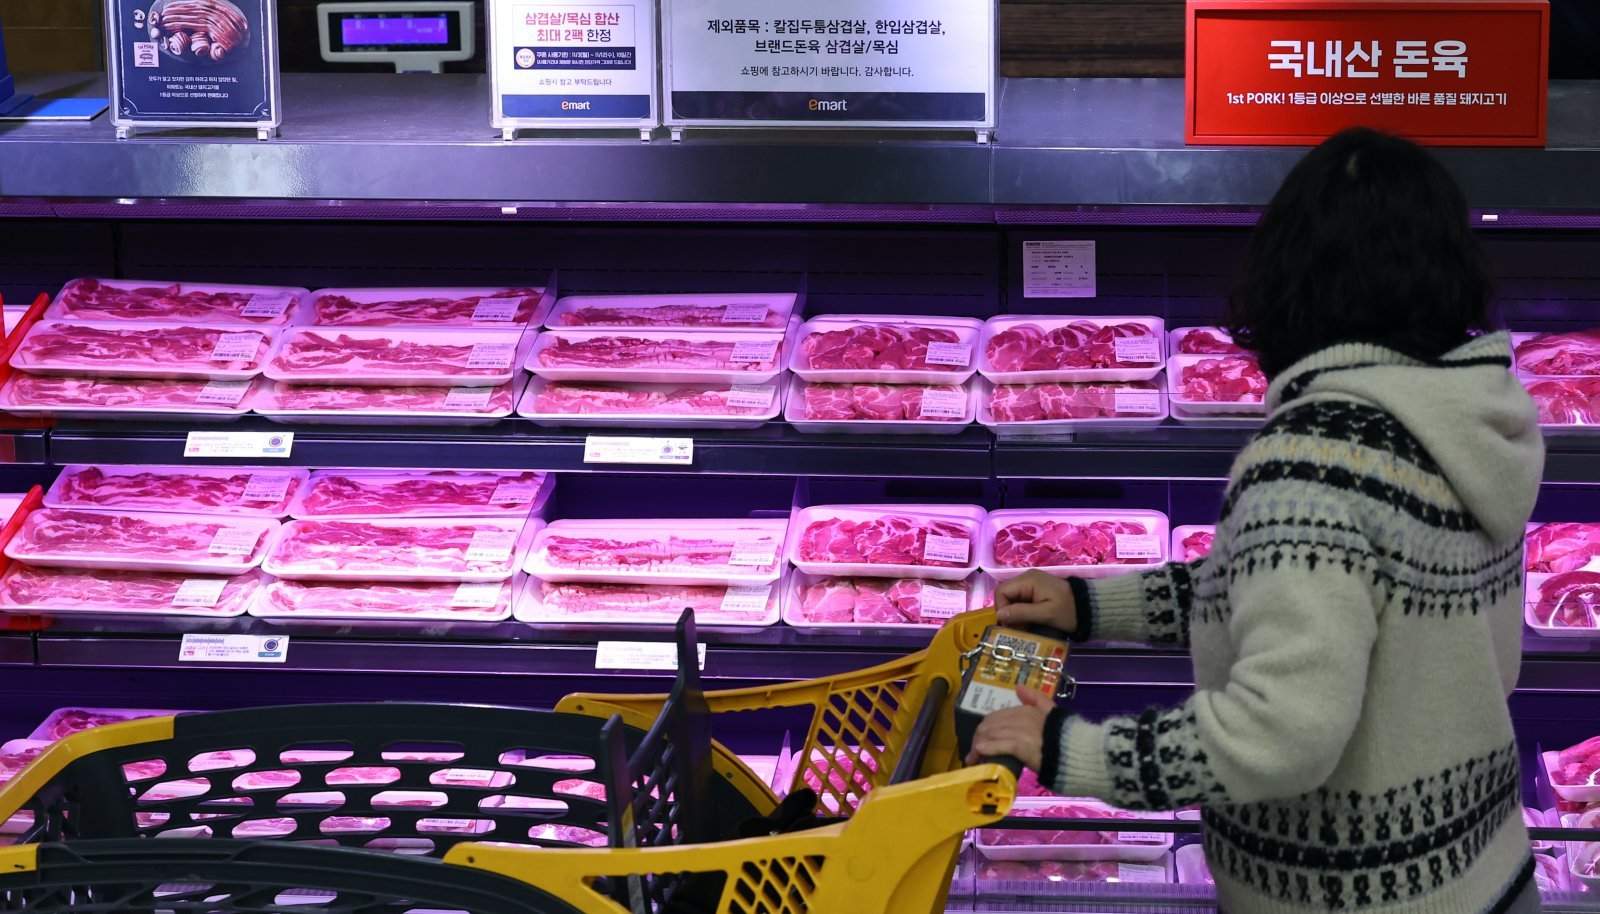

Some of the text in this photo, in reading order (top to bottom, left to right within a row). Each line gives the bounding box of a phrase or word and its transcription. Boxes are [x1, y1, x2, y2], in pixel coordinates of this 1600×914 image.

[525, 12, 620, 26] 삼겹살/목심 합산
[707, 19, 946, 36] 제외품목 : 칼집두툼삼겹살, 한입삼겹살,
[537, 29, 612, 42] 최대 2팩 한정
[754, 39, 898, 54] 브랜드돈육 삼겹살/목심
[1267, 40, 1469, 79] 국내산 돈육
[740, 65, 914, 77] 쇼핑에 참고하시기 바랍니다. 감사합니다.
[539, 78, 612, 87] 쇼핑시 참고 부탁드립니다
[561, 101, 591, 110] emart
[808, 99, 848, 111] emart
[1226, 93, 1508, 106] 1st PORK! 1등급 이상으로 선별한 바른 품질 돼지고기
